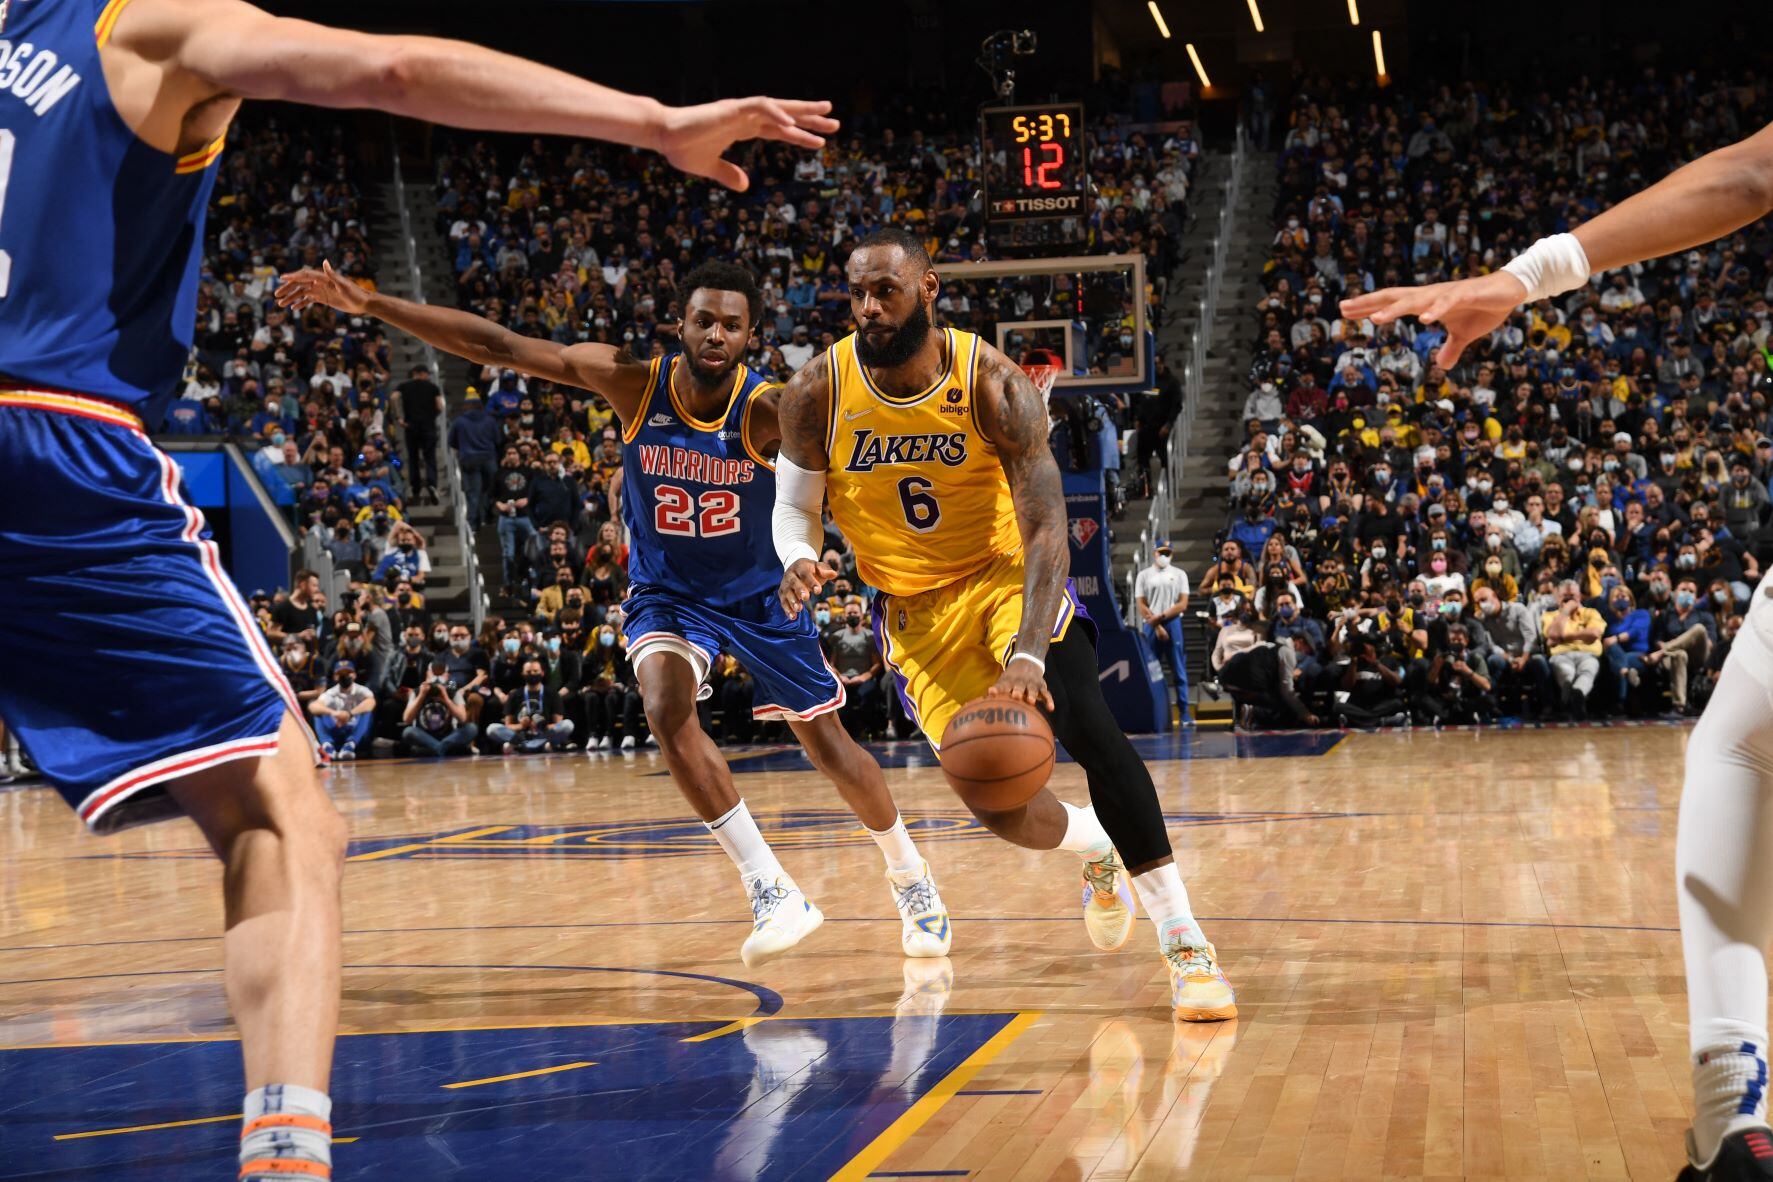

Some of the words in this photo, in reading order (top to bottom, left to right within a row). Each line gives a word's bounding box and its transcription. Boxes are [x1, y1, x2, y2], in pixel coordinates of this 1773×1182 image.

[1012, 113, 1070, 143] 5:37
[1023, 142, 1064, 189] 12
[1016, 196, 1080, 212] TISSOT
[940, 404, 969, 416] bibigo
[639, 444, 755, 485] WARRIORS
[654, 484, 741, 538] 22
[897, 475, 942, 534] 6
